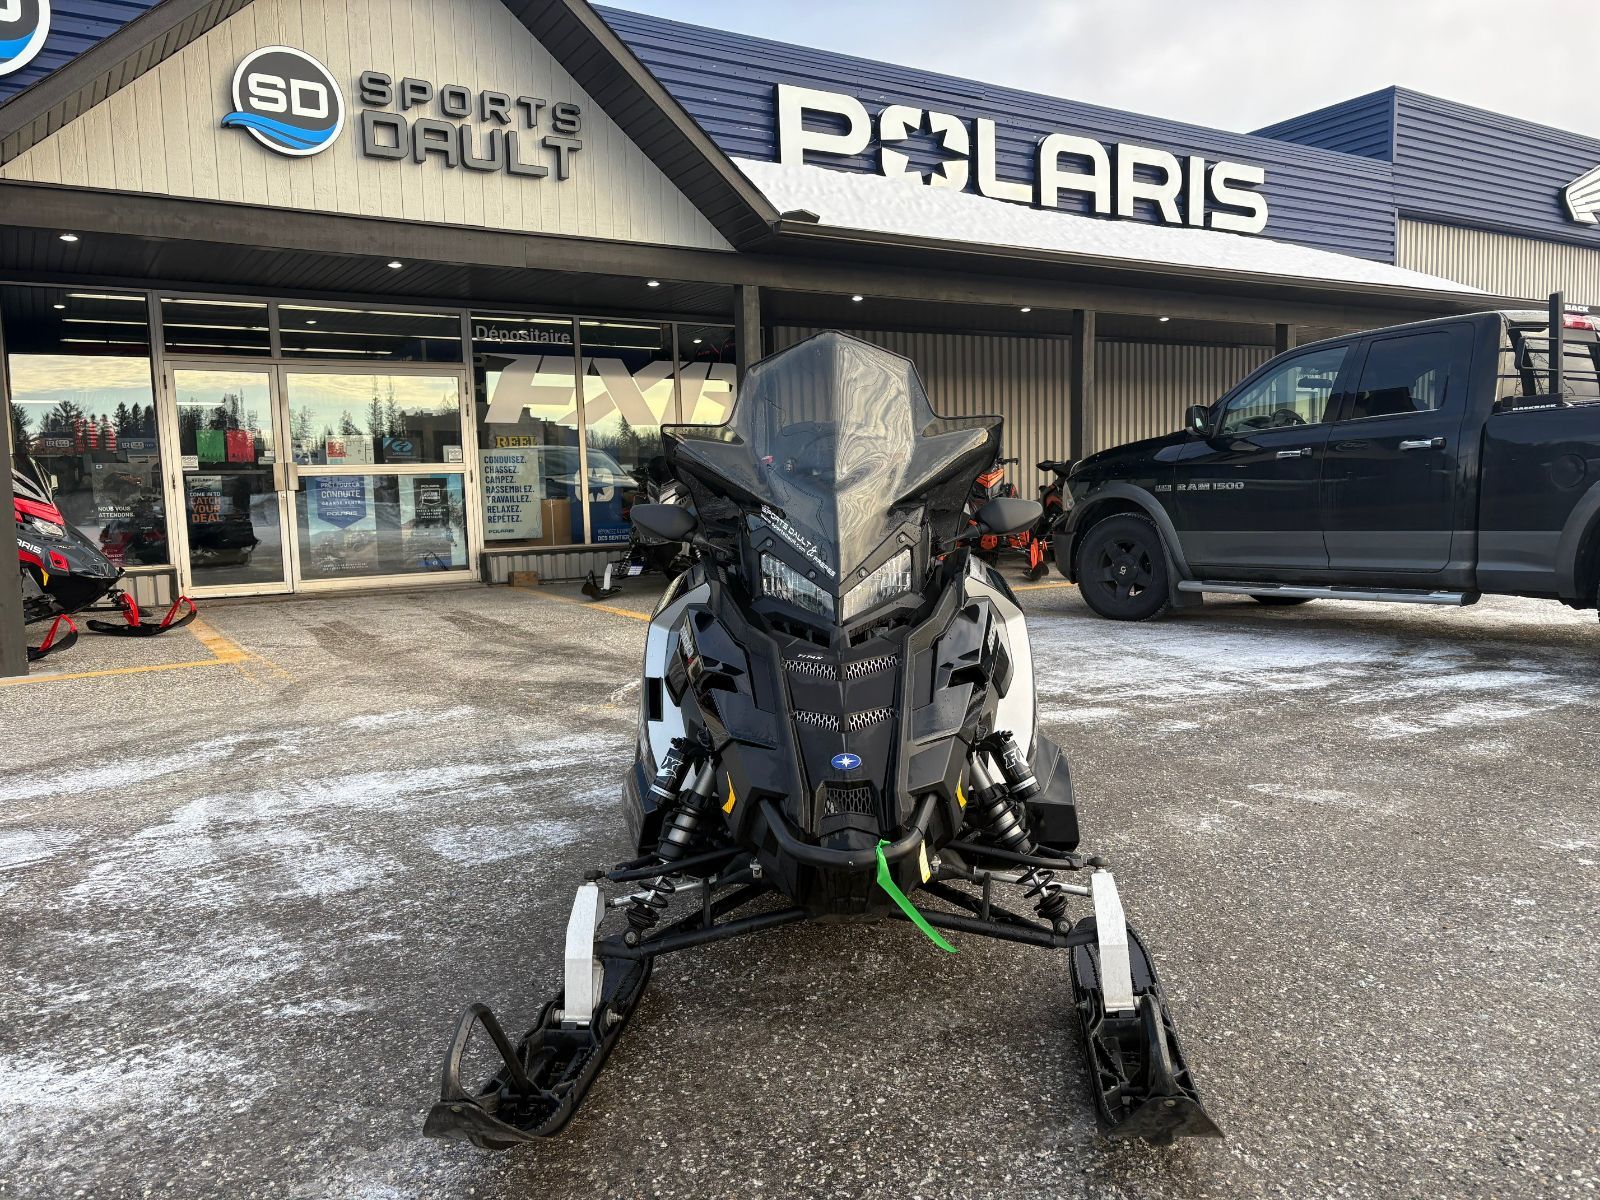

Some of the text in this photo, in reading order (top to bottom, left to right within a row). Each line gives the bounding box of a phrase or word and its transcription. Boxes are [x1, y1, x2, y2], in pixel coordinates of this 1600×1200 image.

[247, 72, 329, 120] SD
[359, 70, 582, 134] SPORTS
[362, 108, 583, 181] DAULT
[775, 83, 1270, 236] POLARIS
[475, 325, 570, 344] Dépositaire
[476, 353, 738, 425] FXR
[495, 436, 537, 448] REEL
[483, 455, 527, 464] CONDUISEZ.
[484, 465, 520, 474] CHASSEZ.
[485, 475, 517, 484] CAMPEZ.
[485, 485, 535, 494] RASSEMBLEZ.
[1176, 482, 1210, 491] RAM
[1212, 481, 1245, 490] 1500
[321, 489, 361, 498] CONDUITE
[190, 497, 221, 505] CATCH
[486, 495, 532, 504] TRAVAILLEZ.
[191, 504, 221, 513] YOUR
[487, 505, 522, 514] RELAXEZ.
[191, 513, 223, 523] DEAL
[487, 514, 523, 524] RÉPÉTEZ.
